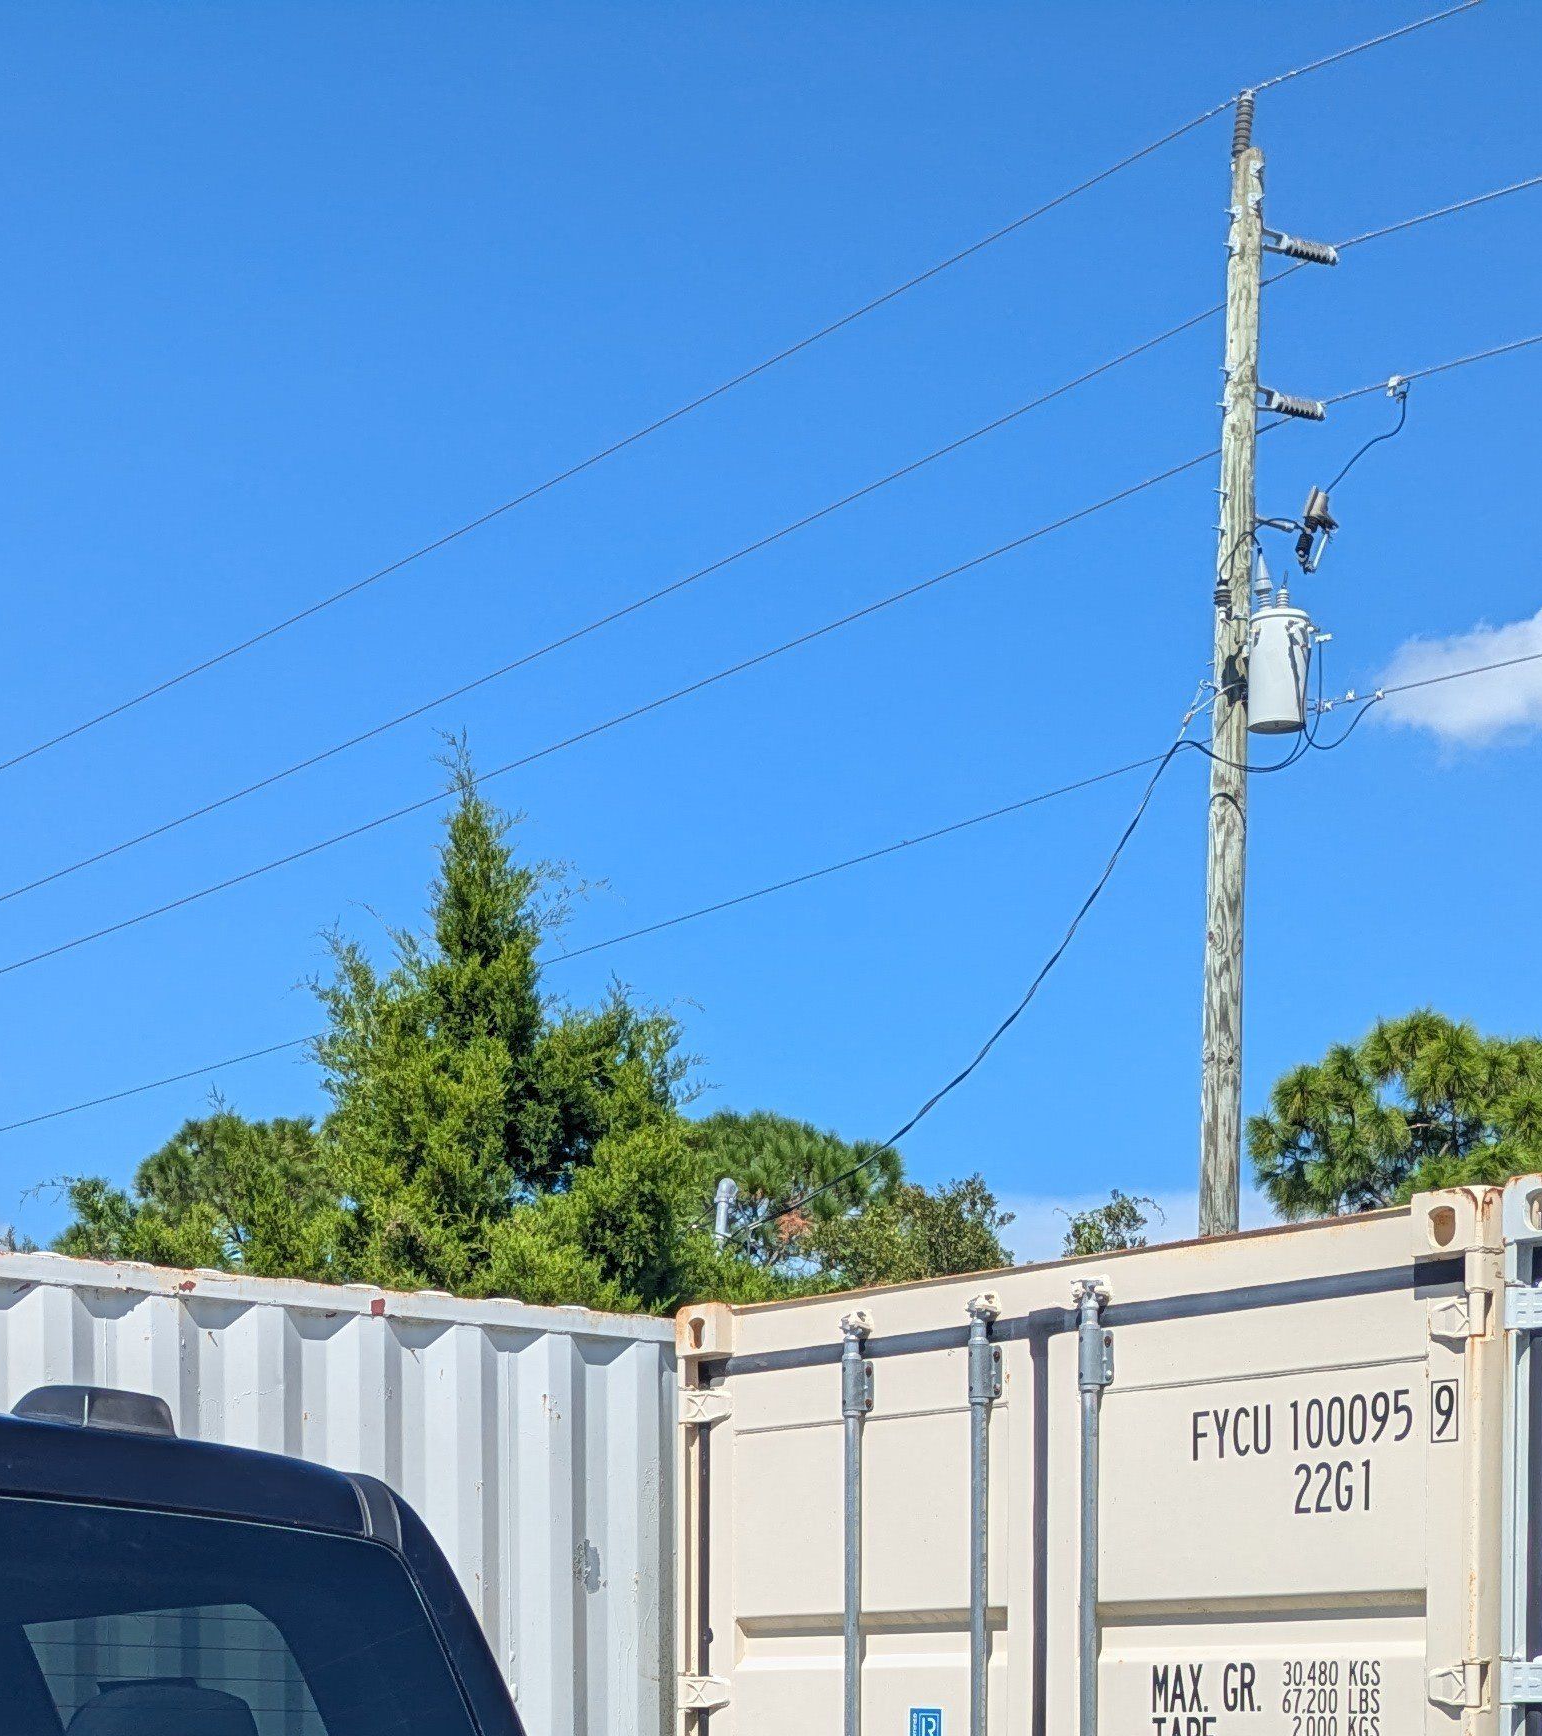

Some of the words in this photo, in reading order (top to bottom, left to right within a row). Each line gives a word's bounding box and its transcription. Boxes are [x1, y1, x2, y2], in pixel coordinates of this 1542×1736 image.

[1193, 1404, 1271, 1461] FYCU
[1290, 1389, 1412, 1451] 100095
[1435, 1385, 1454, 1437] 9
[1294, 1459, 1371, 1514] 22G1
[1152, 1664, 1208, 1713] MAX.
[1223, 1663, 1261, 1712] GR.
[1283, 1661, 1338, 1687] 30,480
[1349, 1661, 1381, 1686] KGS
[1282, 1689, 1337, 1714] 67,200
[1348, 1689, 1380, 1714] LBS
